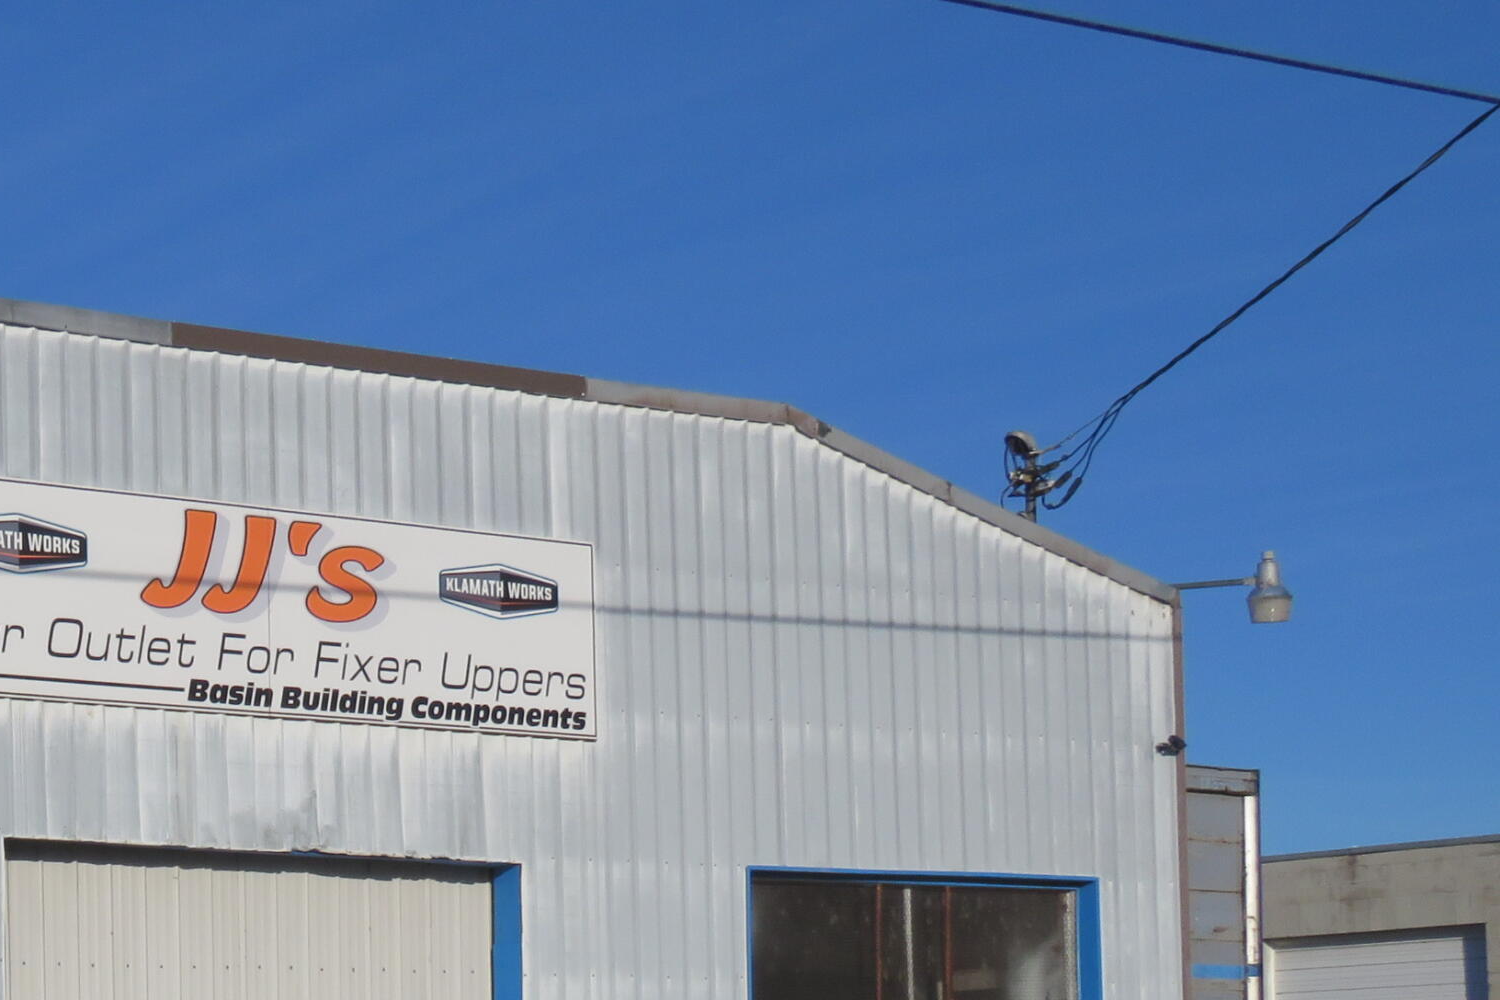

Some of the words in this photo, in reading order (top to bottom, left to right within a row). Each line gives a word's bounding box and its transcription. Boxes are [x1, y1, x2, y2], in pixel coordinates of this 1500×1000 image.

[27, 532, 81, 554] WORKS
[445, 577, 504, 598] KLAMATH
[507, 581, 553, 601] WORKS
[47, 617, 197, 668] Outlet
[217, 632, 295, 675] For
[313, 640, 422, 685] Fixer
[441, 651, 587, 701] Uppers
[187, 678, 274, 708] Basin
[280, 686, 404, 721] Building
[410, 696, 587, 731] Components
